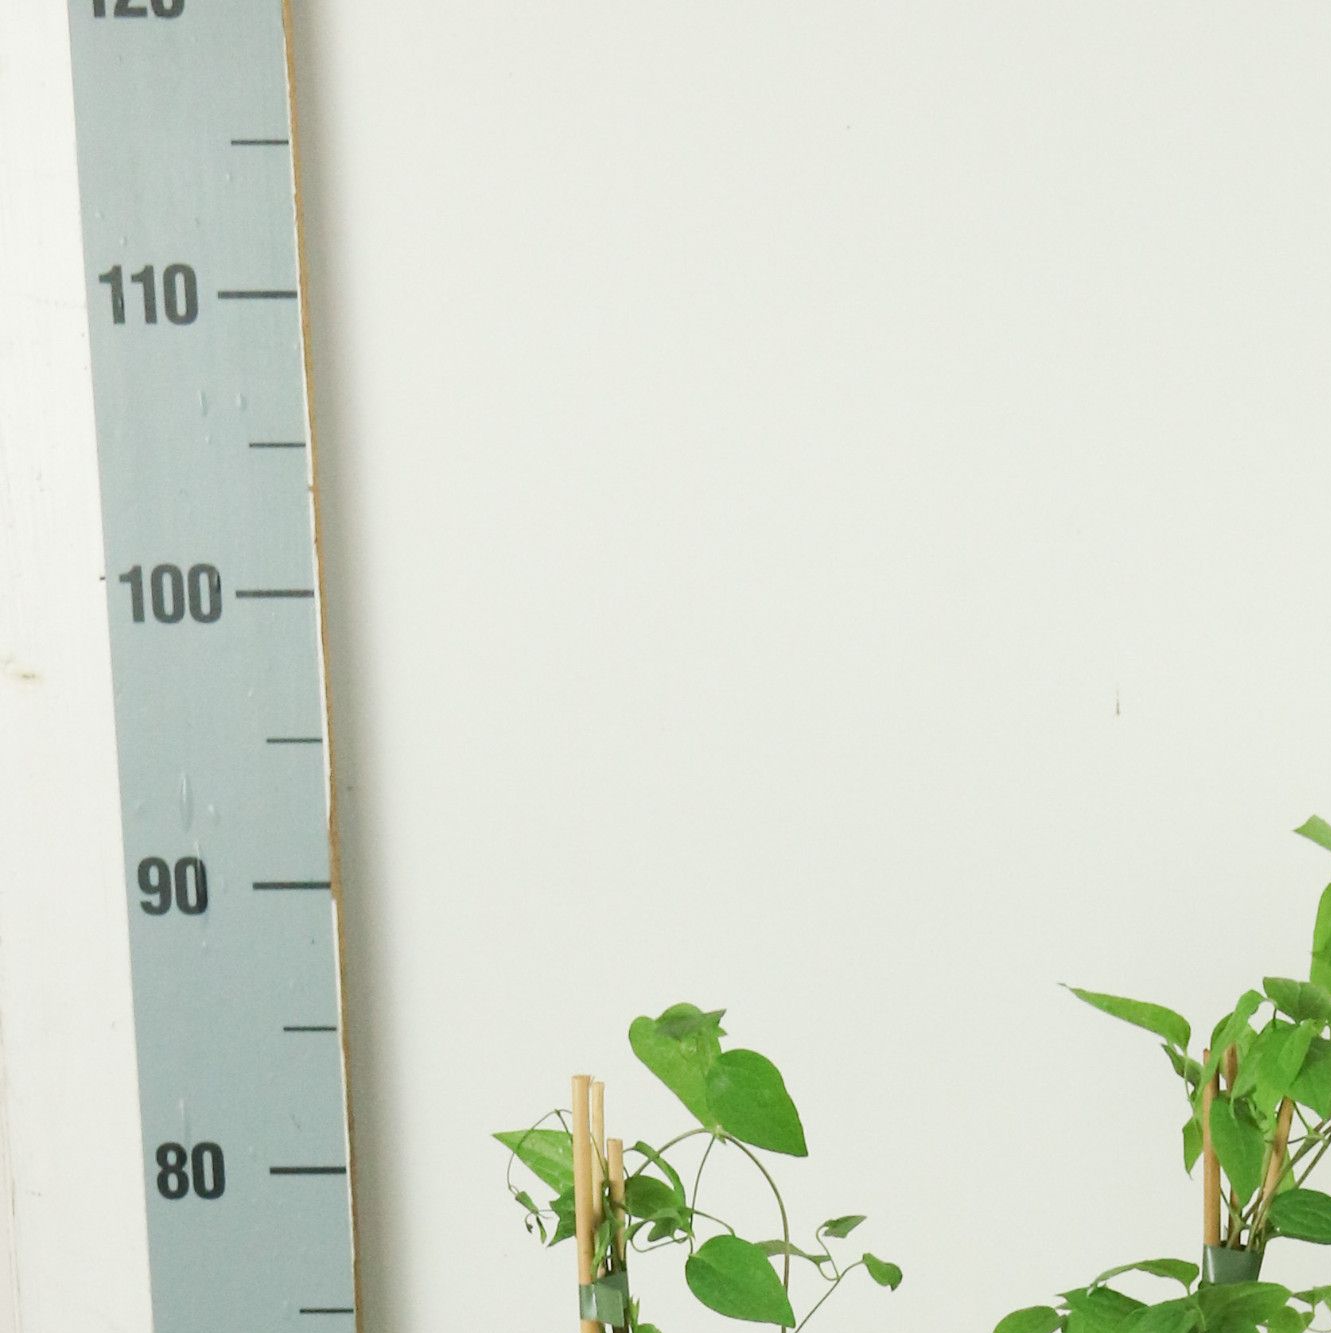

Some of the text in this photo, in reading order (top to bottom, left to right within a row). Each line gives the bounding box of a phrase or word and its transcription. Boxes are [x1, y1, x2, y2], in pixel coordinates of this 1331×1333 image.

[98, 263, 198, 325] 110
[119, 563, 222, 624] 100
[138, 856, 209, 916] 90
[156, 1141, 225, 1200] 80
